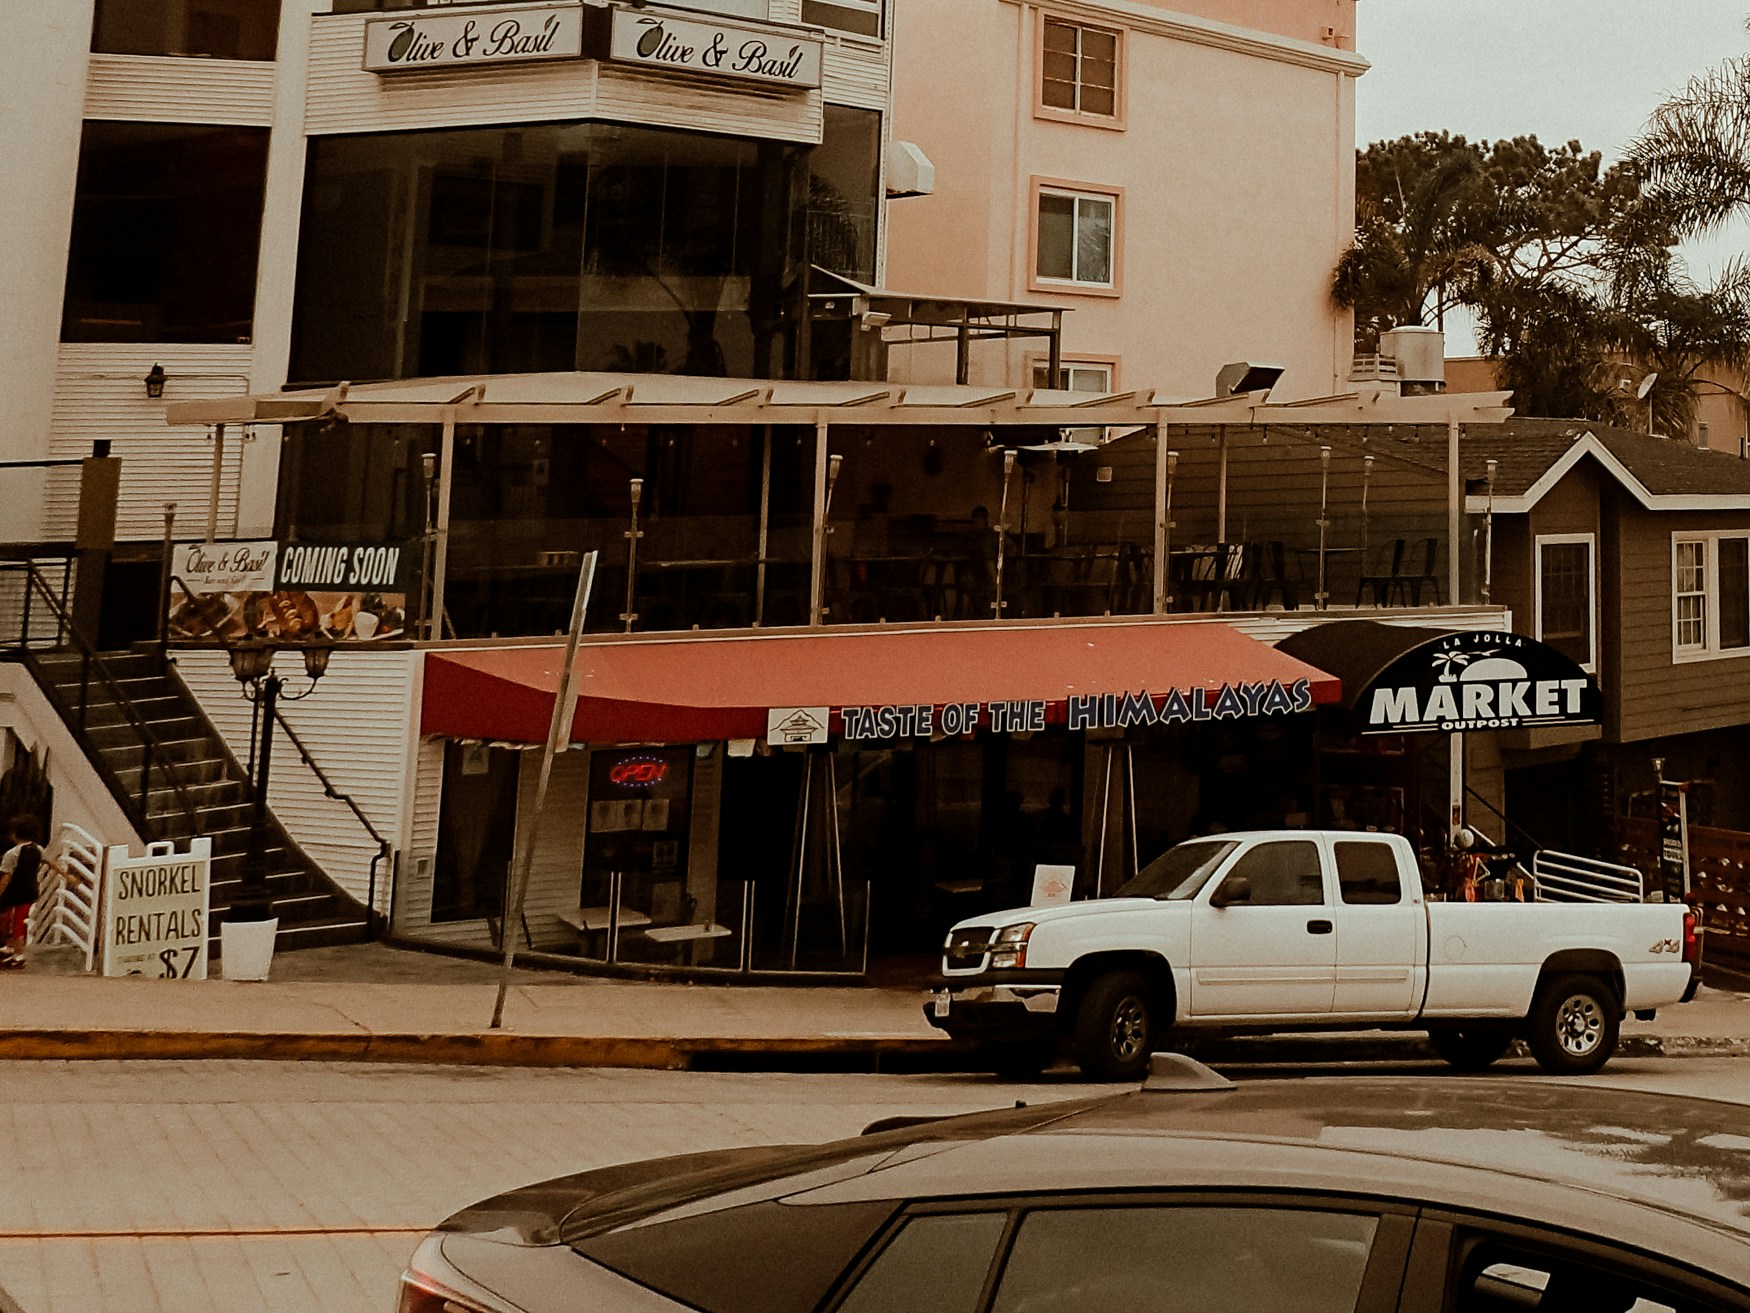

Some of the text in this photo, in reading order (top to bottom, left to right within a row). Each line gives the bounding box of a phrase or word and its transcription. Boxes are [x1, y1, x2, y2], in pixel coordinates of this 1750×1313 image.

[388, 14, 561, 62] Olive & Basil
[636, 18, 803, 78] Olive & Basil
[217, 551, 229, 572] &
[230, 547, 270, 573] Basil
[280, 546, 400, 585] COMING SOON
[1443, 634, 1522, 649] LA JOLLA
[841, 678, 1312, 739] TASTE OF THE HIMALAYAS
[1369, 679, 1587, 724] MARKET
[1441, 718, 1519, 730] OUTPOST
[610, 763, 668, 783] OPEN
[118, 865, 201, 900] SNORKEL
[115, 909, 201, 945] RENTALS
[159, 946, 200, 979] $7
